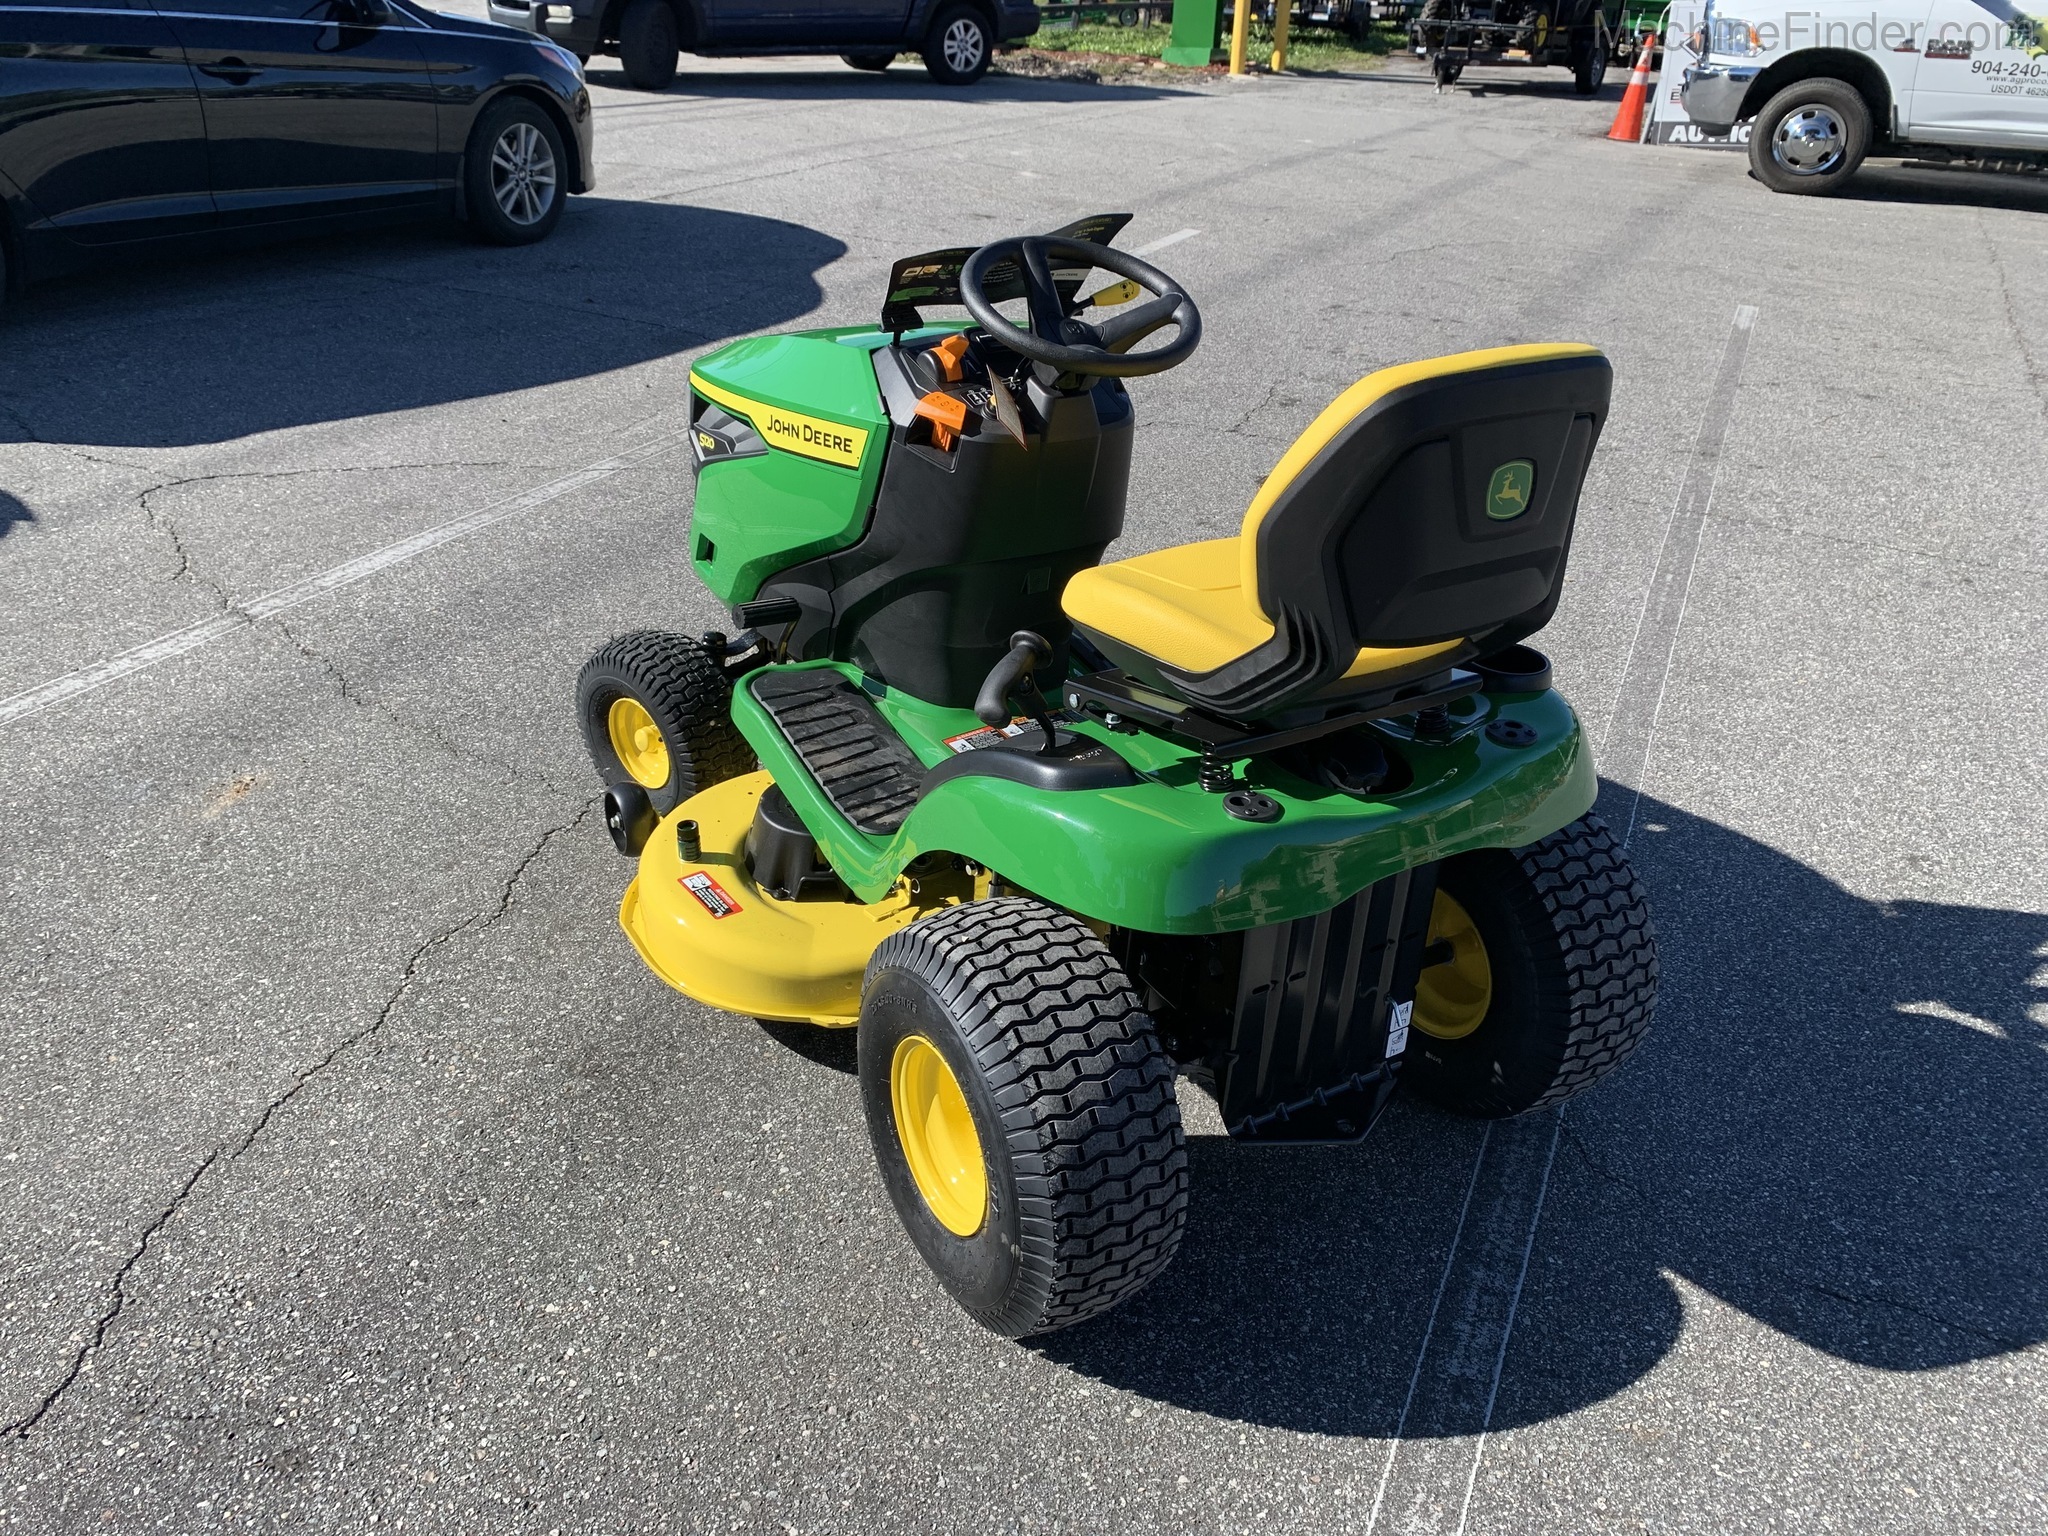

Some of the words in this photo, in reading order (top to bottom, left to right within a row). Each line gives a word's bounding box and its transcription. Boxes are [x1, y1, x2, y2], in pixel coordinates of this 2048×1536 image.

[1971, 60, 2048, 78] 904-240-
[1991, 84, 2024, 95] USDOT
[767, 414, 800, 440] JOHN
[803, 424, 853, 454] DEERE
